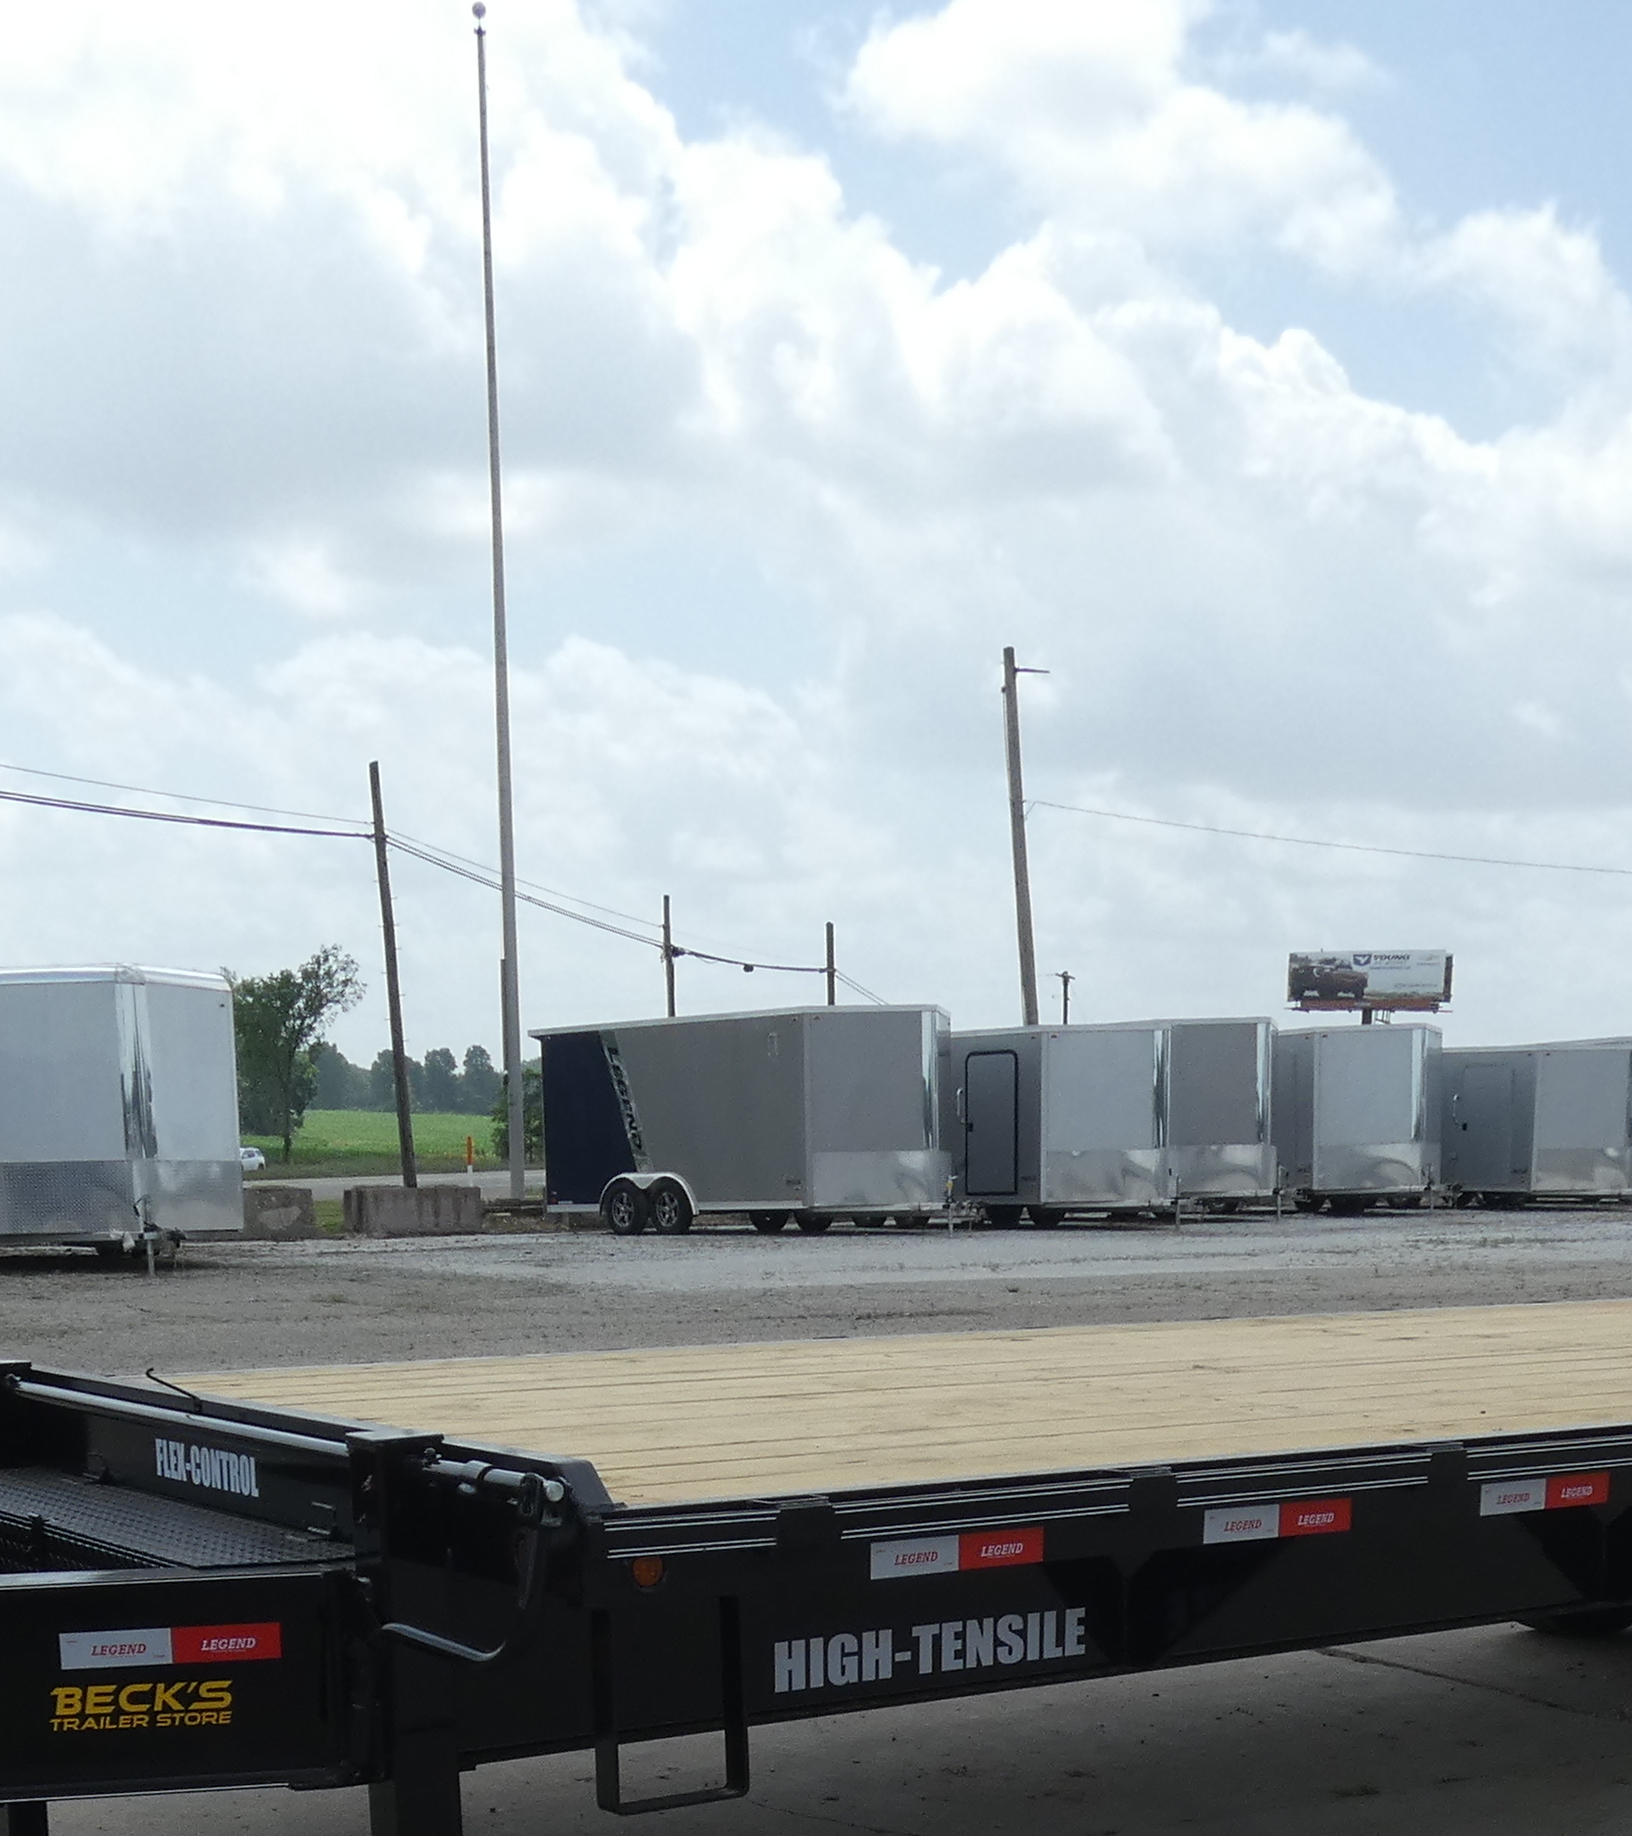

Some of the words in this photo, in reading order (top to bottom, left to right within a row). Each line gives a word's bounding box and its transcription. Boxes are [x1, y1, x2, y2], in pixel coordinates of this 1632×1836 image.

[155, 1438, 259, 1498] FLEX-CONTROL
[1496, 1493, 1530, 1505] LEGEND
[1561, 1486, 1593, 1498] LEGEND
[1224, 1519, 1263, 1532] LEGEND
[1297, 1513, 1335, 1526] LEGEND
[894, 1551, 939, 1566] LEGEND
[980, 1542, 1024, 1557] LEGEND
[91, 1643, 147, 1657] LEGEND
[201, 1637, 257, 1651] LEGEND
[774, 1607, 1086, 1693] HIGH-TENSILE
[50, 1680, 233, 1715] BECK'S
[50, 1713, 149, 1732] TRAILER
[156, 1710, 233, 1727] STORE
